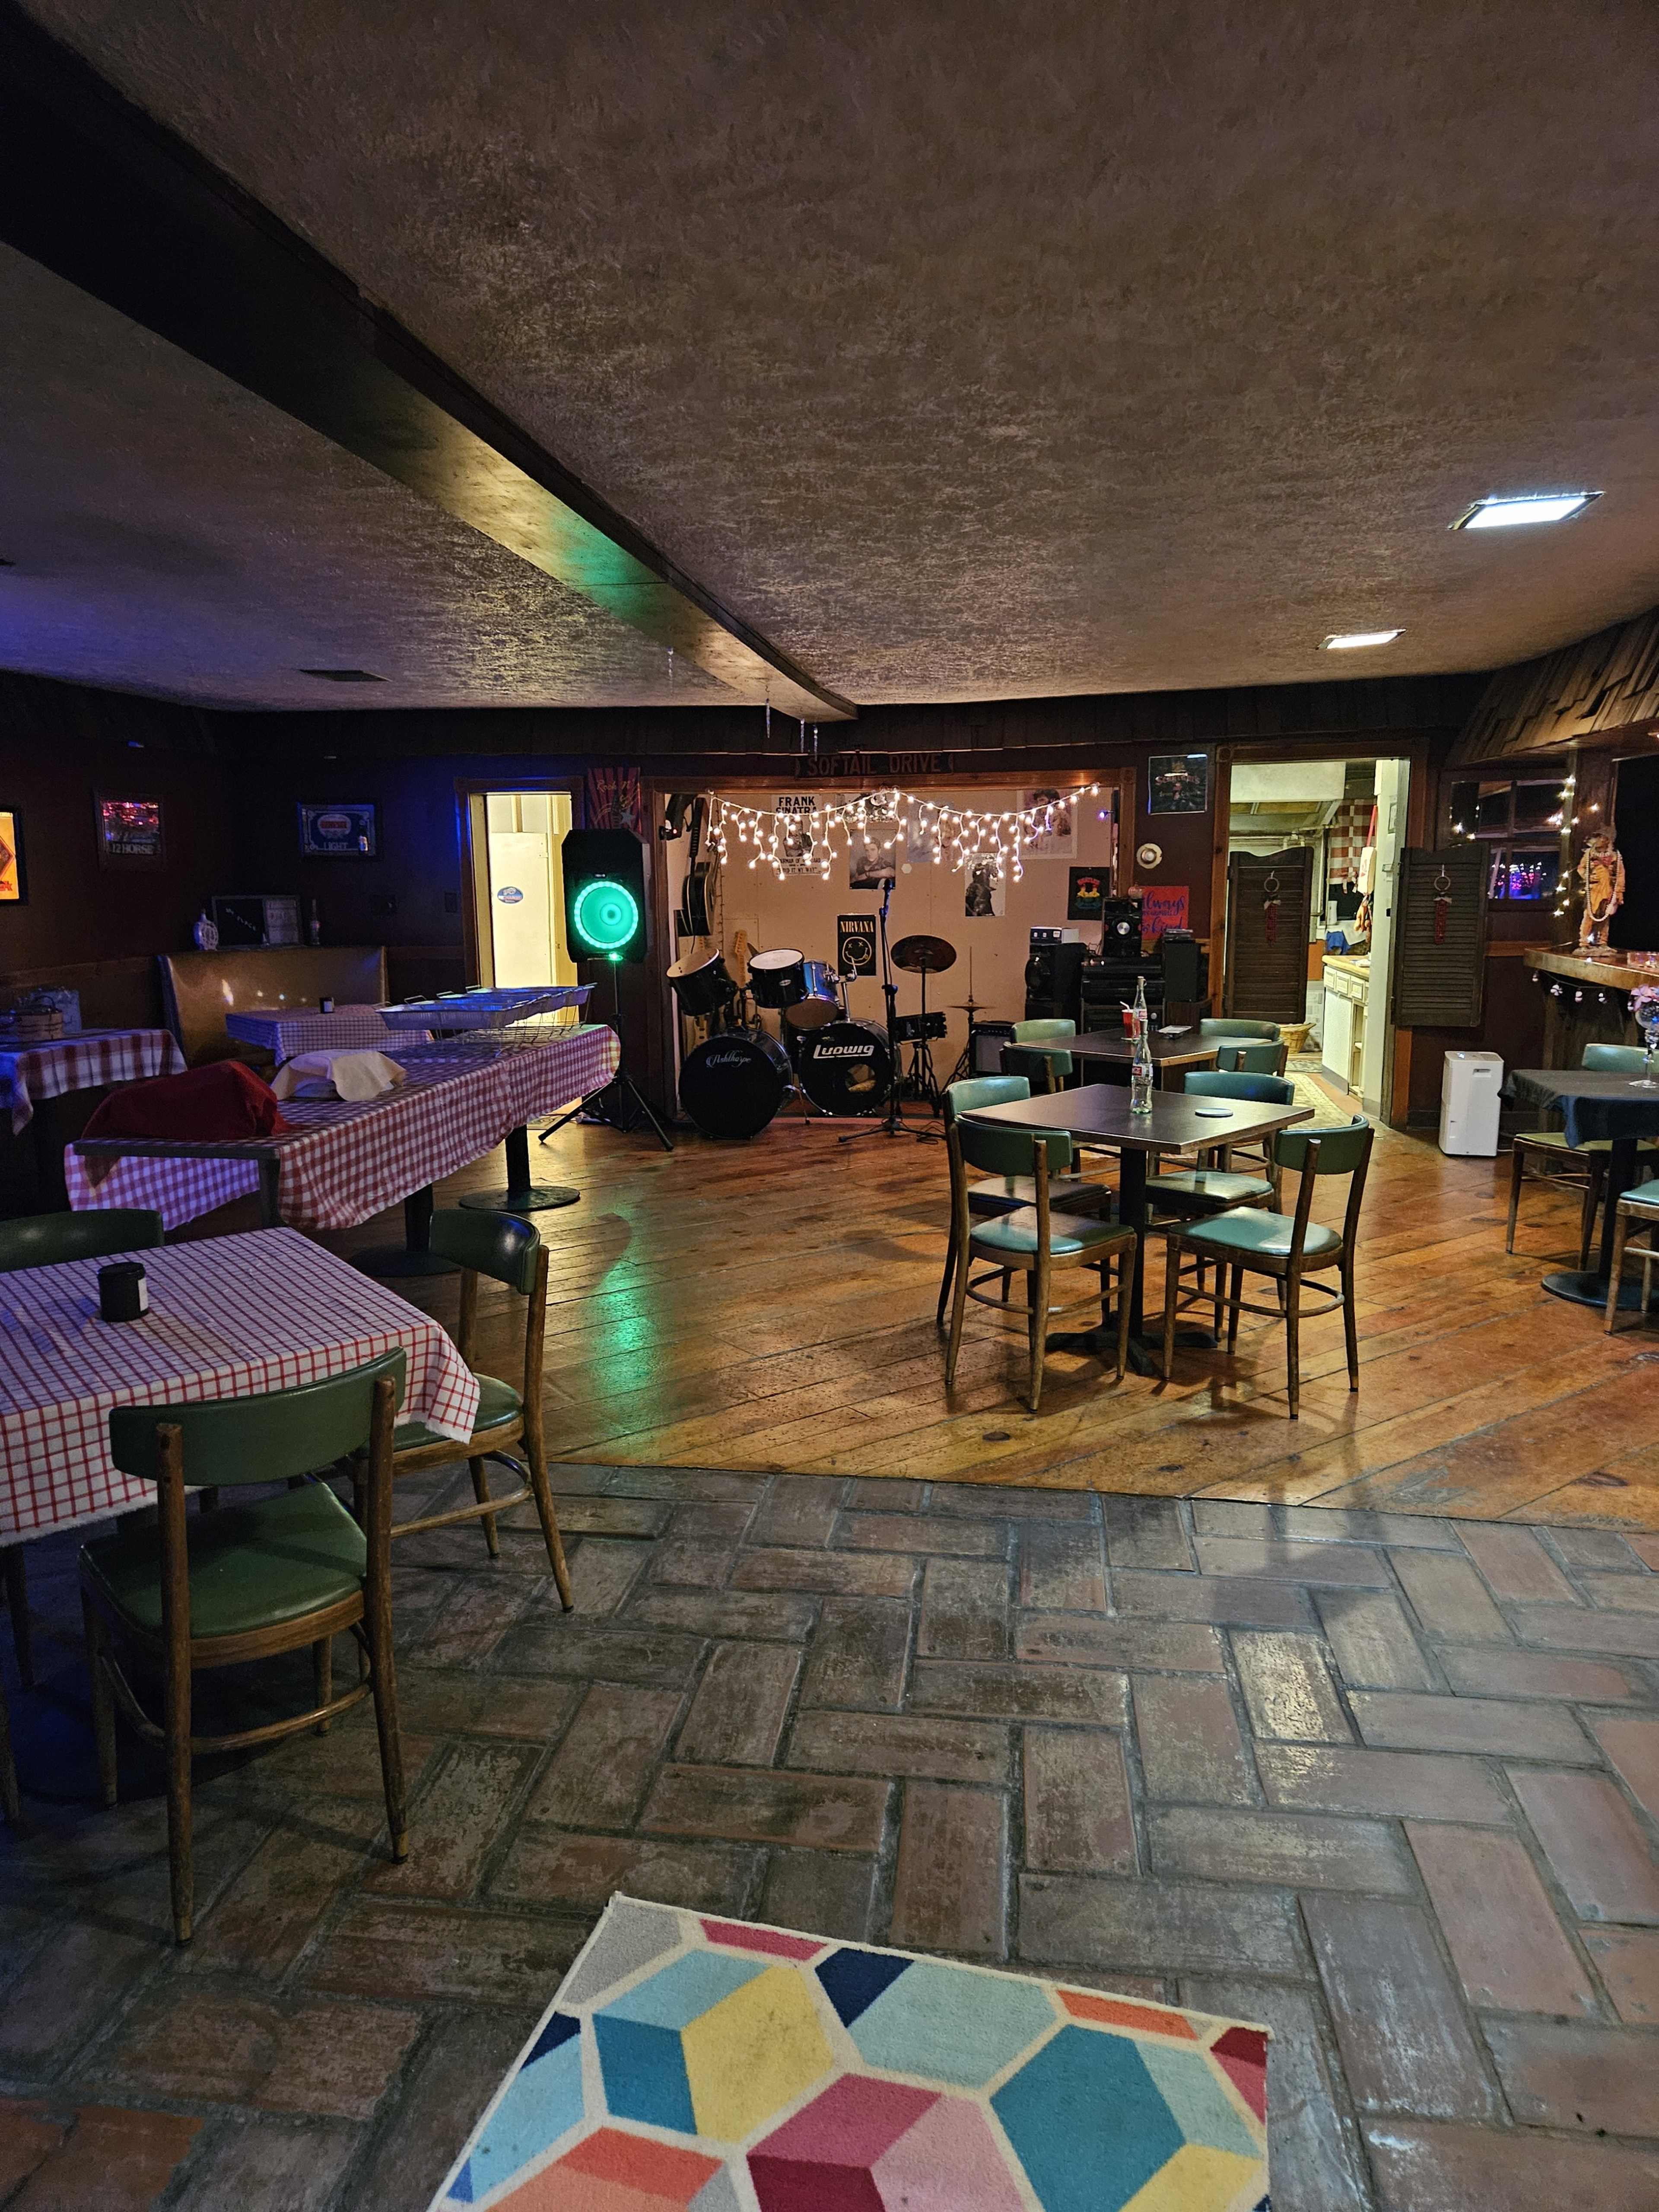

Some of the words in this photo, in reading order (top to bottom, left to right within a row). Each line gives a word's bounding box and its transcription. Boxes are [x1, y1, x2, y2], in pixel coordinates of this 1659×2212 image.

[808, 755, 877, 775] SOFTAIL
[889, 753, 941, 773] DRIVE
[779, 796, 815, 807] FRANK
[840, 921, 874, 933] NIRVANA
[813, 1045, 875, 1059] Ludwig
